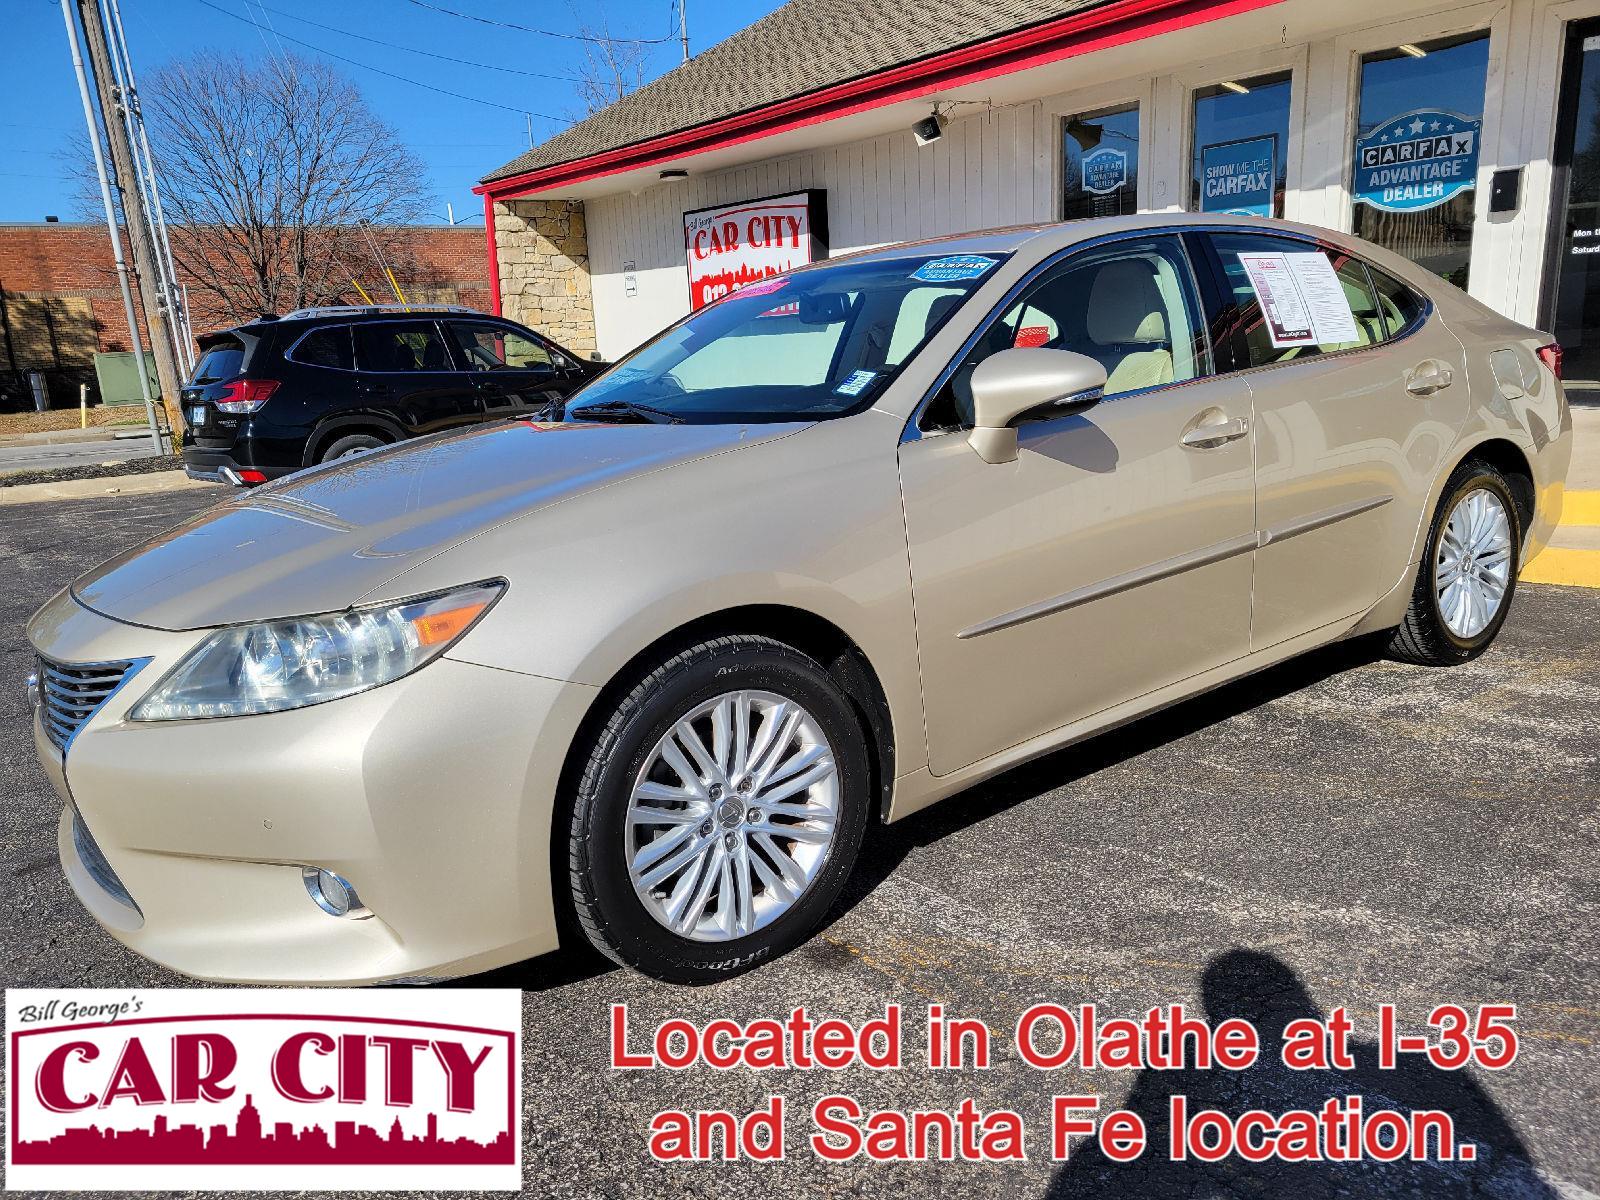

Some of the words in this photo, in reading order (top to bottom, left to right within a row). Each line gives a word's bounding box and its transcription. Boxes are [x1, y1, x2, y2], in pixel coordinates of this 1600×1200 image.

[1364, 134, 1471, 167] CARFAX
[1088, 160, 1122, 173] CARFAX
[1207, 163, 1235, 179] SHOW
[1236, 161, 1250, 174] ME
[1252, 159, 1269, 171] THE
[1369, 160, 1462, 187] ADVANTAGE
[1206, 171, 1269, 198] CARFAX
[1383, 180, 1444, 203] DEALER
[693, 221, 739, 261] CAR
[747, 215, 803, 249] CITY
[1573, 229, 1592, 238] Mon
